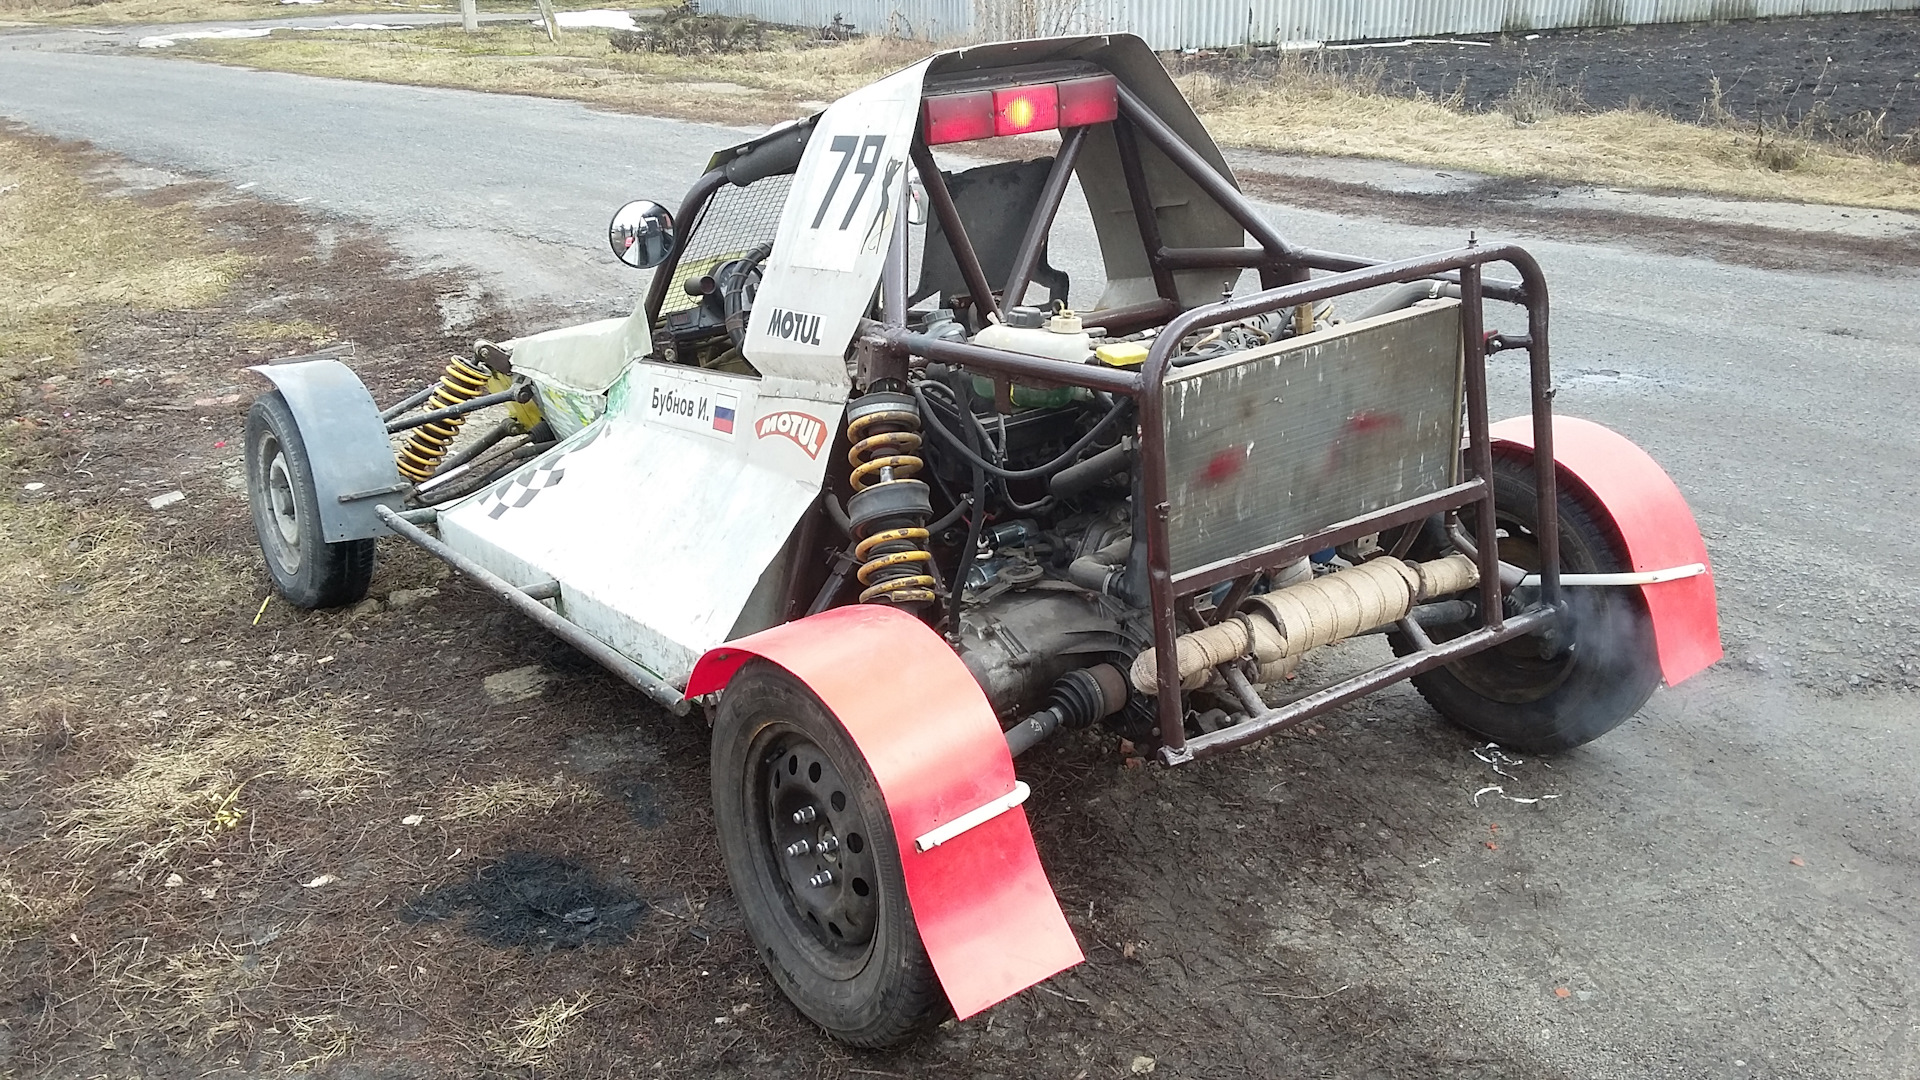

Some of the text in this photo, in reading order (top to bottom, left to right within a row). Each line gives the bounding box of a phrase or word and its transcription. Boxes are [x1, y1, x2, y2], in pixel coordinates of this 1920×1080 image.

[810, 135, 887, 231] 79
[767, 308, 821, 346] MOTUL
[651, 387, 709, 422] Бубнов И.
[759, 413, 822, 455] MOTUL
